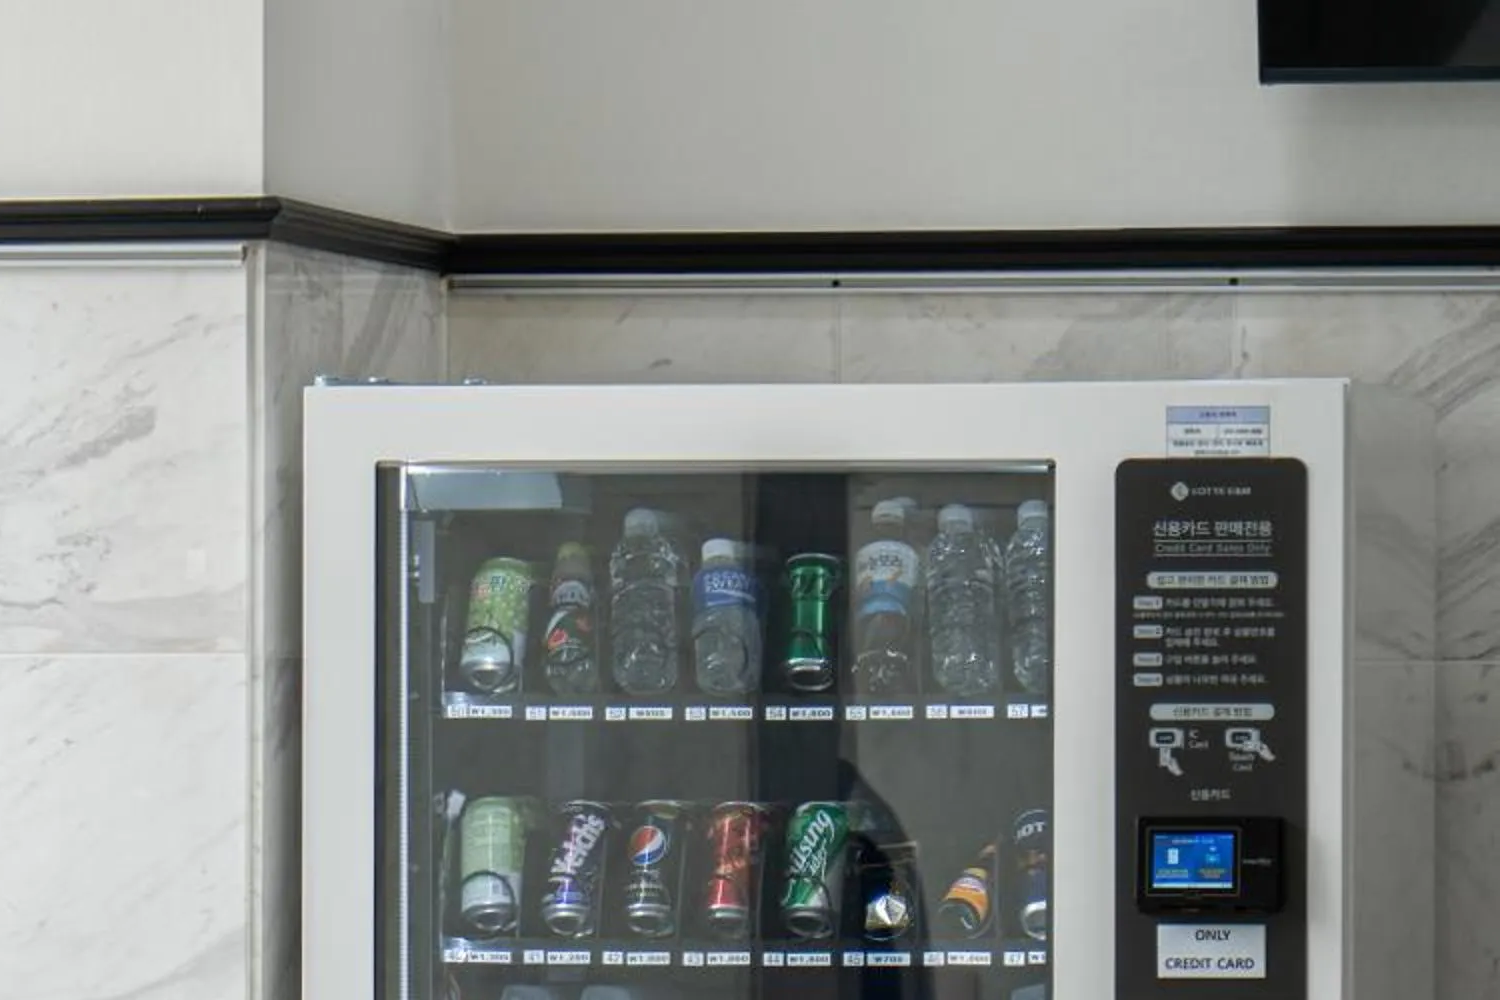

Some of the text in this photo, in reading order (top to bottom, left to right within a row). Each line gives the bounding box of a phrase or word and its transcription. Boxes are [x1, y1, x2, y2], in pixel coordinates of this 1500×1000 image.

[1155, 520, 1272, 538] 신용카드 판매전용
[1195, 929, 1231, 941] ONLY
[1164, 957, 1256, 970] CREDIT CARD
